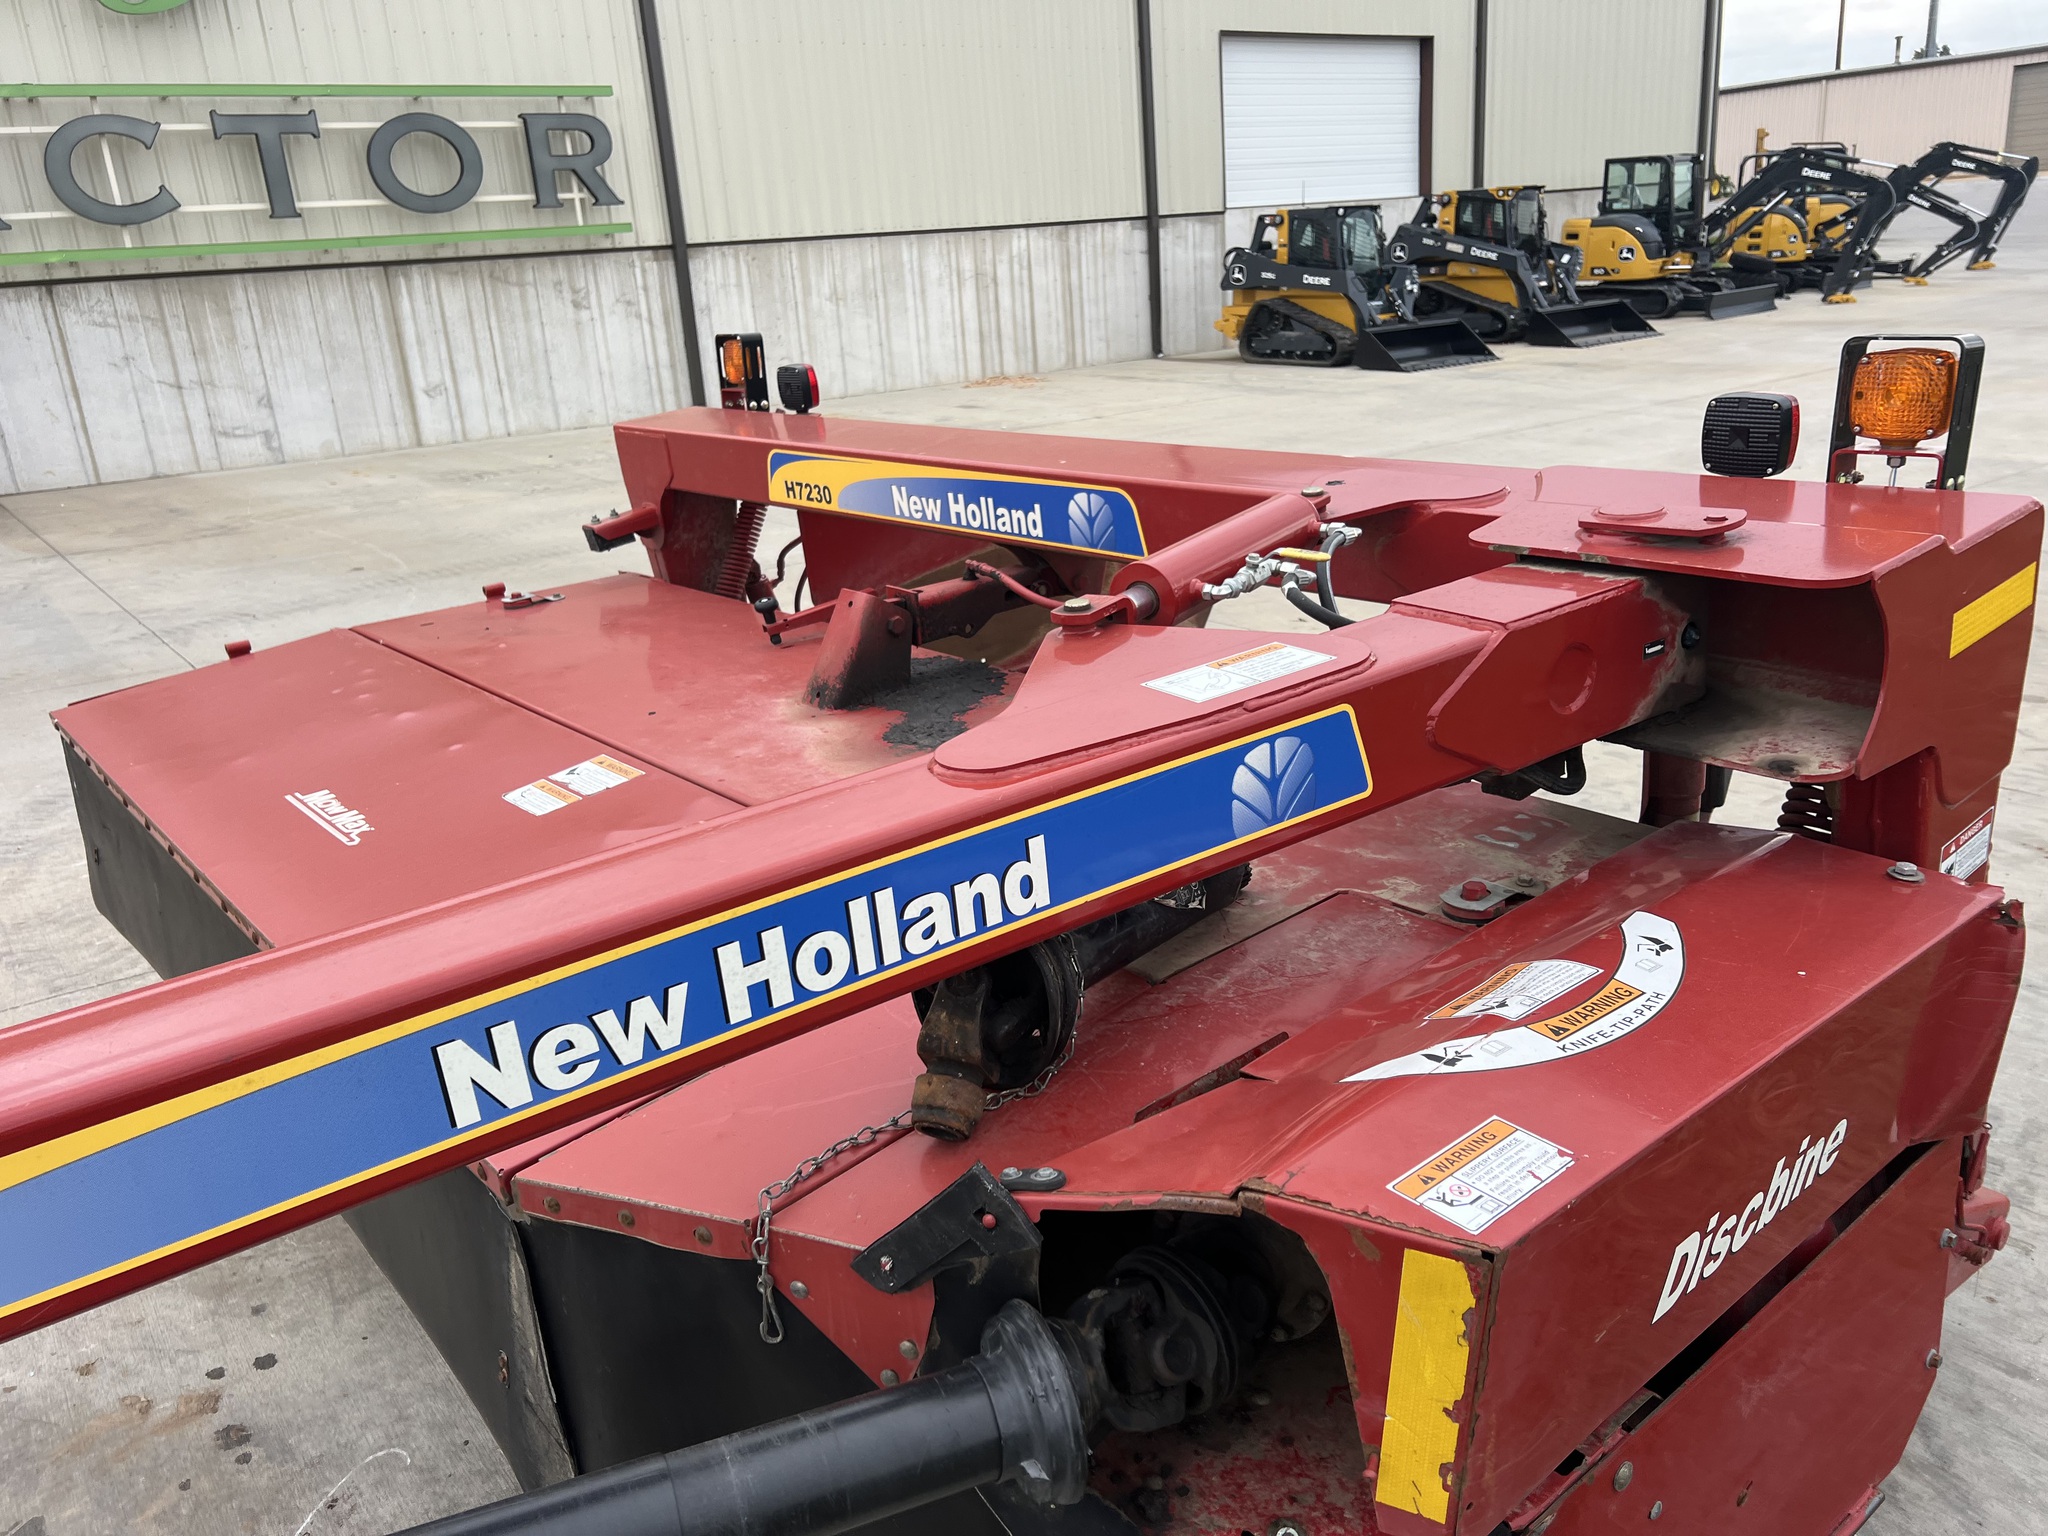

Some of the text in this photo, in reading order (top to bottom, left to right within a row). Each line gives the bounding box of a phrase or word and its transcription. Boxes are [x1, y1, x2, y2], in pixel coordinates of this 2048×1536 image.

[0, 110, 624, 230] CTOR
[1801, 167, 1832, 181] DEERE
[1952, 158, 1977, 170] DEERE
[1907, 193, 1932, 209] DEERE
[1469, 246, 1499, 261] DEERE
[1302, 274, 1331, 286] DEERE
[784, 480, 833, 506] H7230
[891, 484, 1044, 539] New Holland
[435, 833, 1052, 1130] New Holland
[1463, 967, 1518, 1003] WARNING
[1556, 991, 1667, 1054] KNIFE-TIP-PATH
[1559, 986, 1635, 1028] WARNING
[1431, 1131, 1498, 1174] WARNING
[1460, 1136, 1522, 1178] SLIPPERY SURFACE
[1652, 1118, 1848, 1325] Discbine
